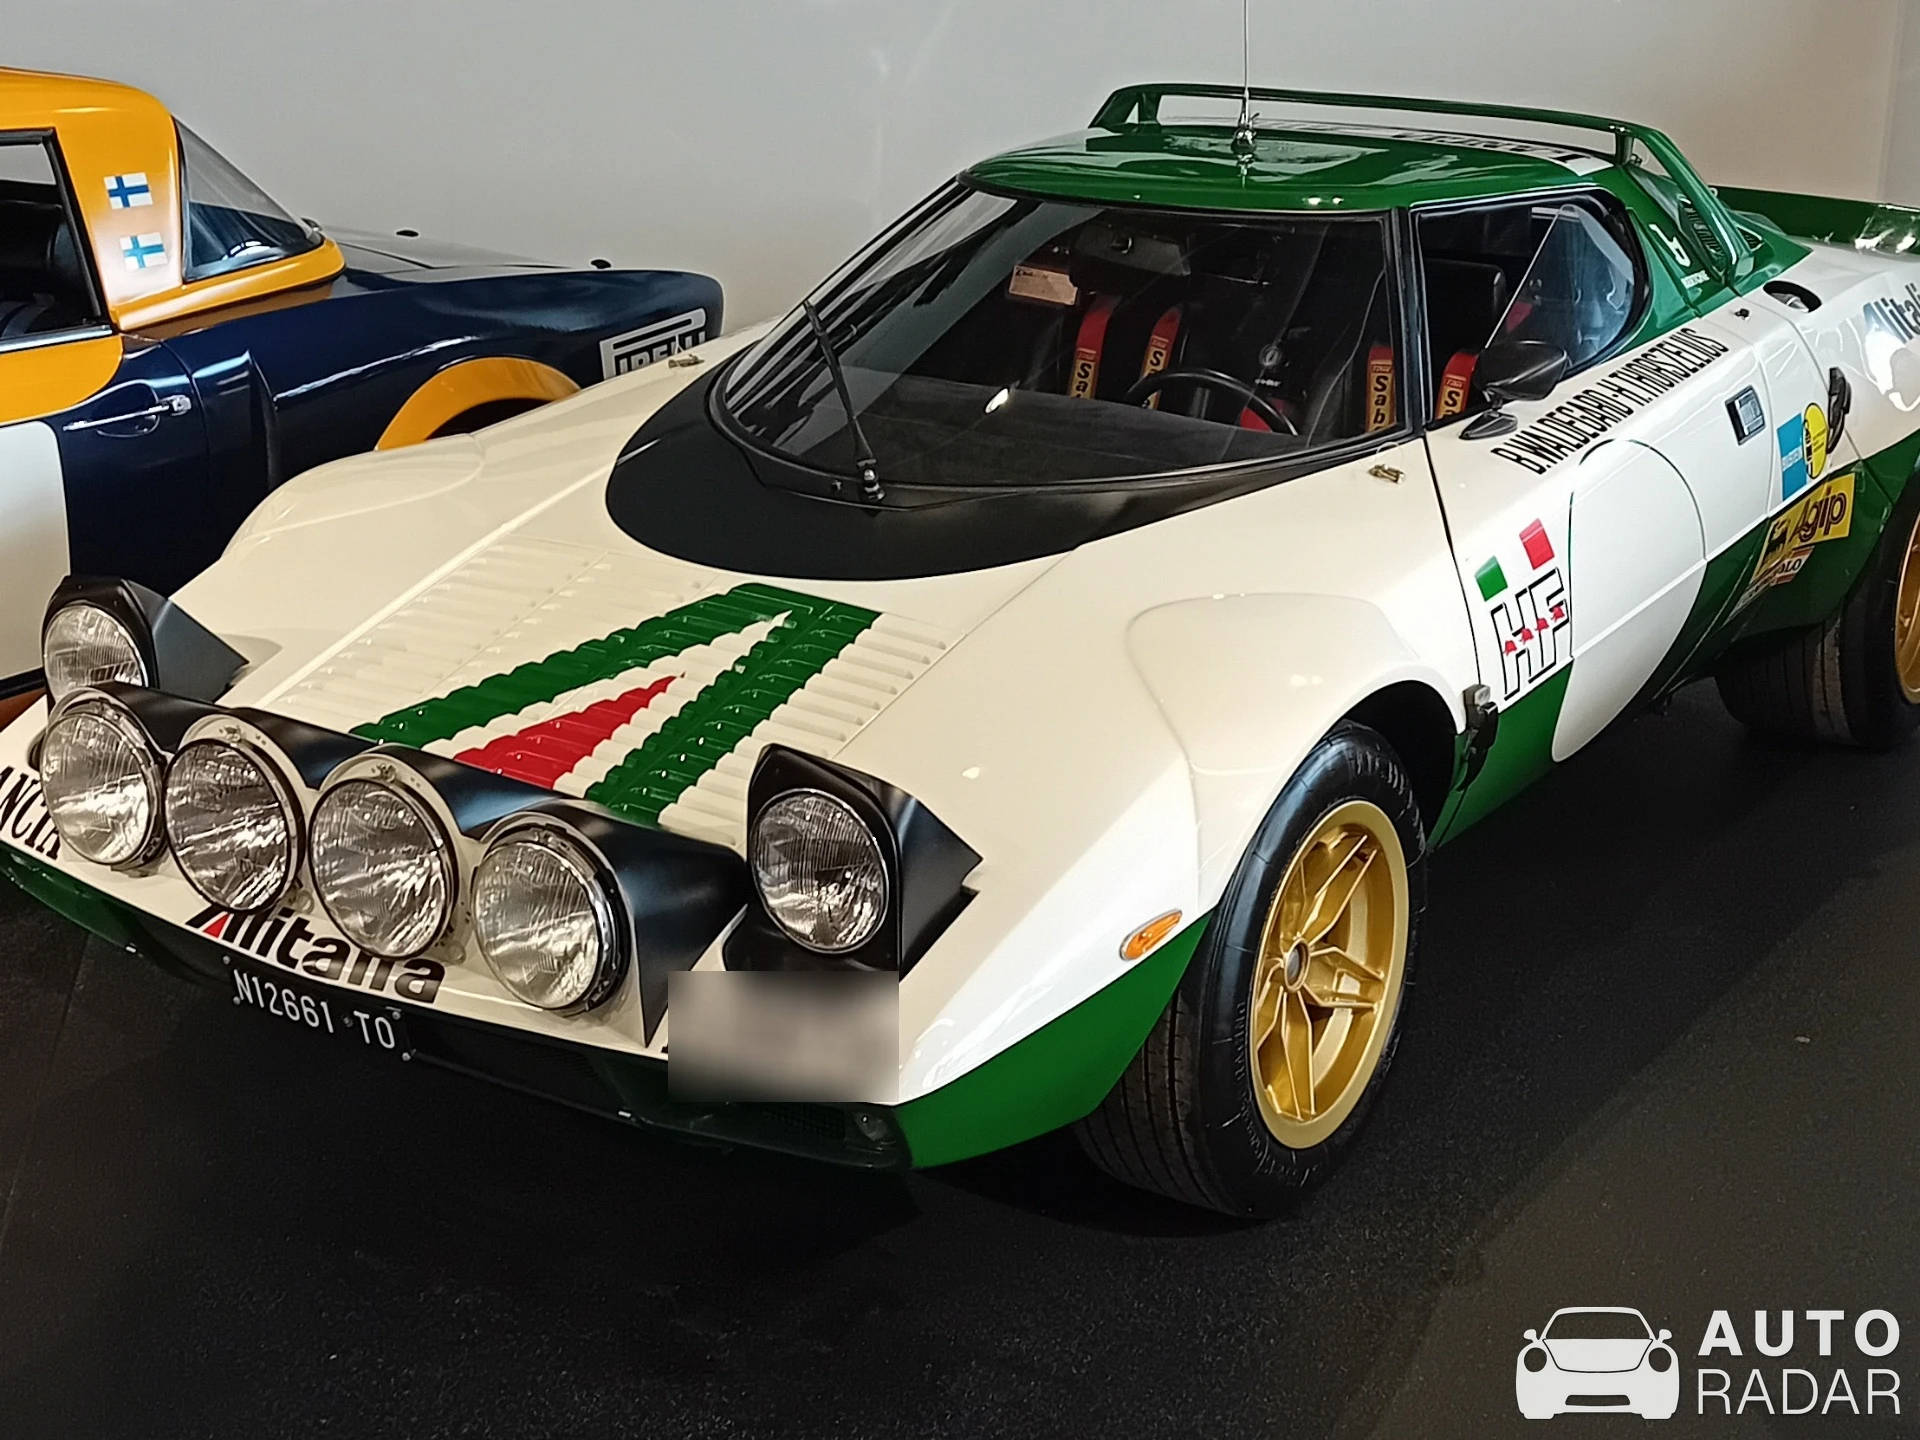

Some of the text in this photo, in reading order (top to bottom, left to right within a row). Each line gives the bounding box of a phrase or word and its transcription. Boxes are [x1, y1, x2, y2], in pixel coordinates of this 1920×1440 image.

[1863, 282, 1920, 344] Alital
[1373, 375, 1389, 431] Sab
[1789, 486, 1846, 543] Agip
[1490, 566, 1569, 701] HF
[233, 969, 396, 1049] N12661 TO
